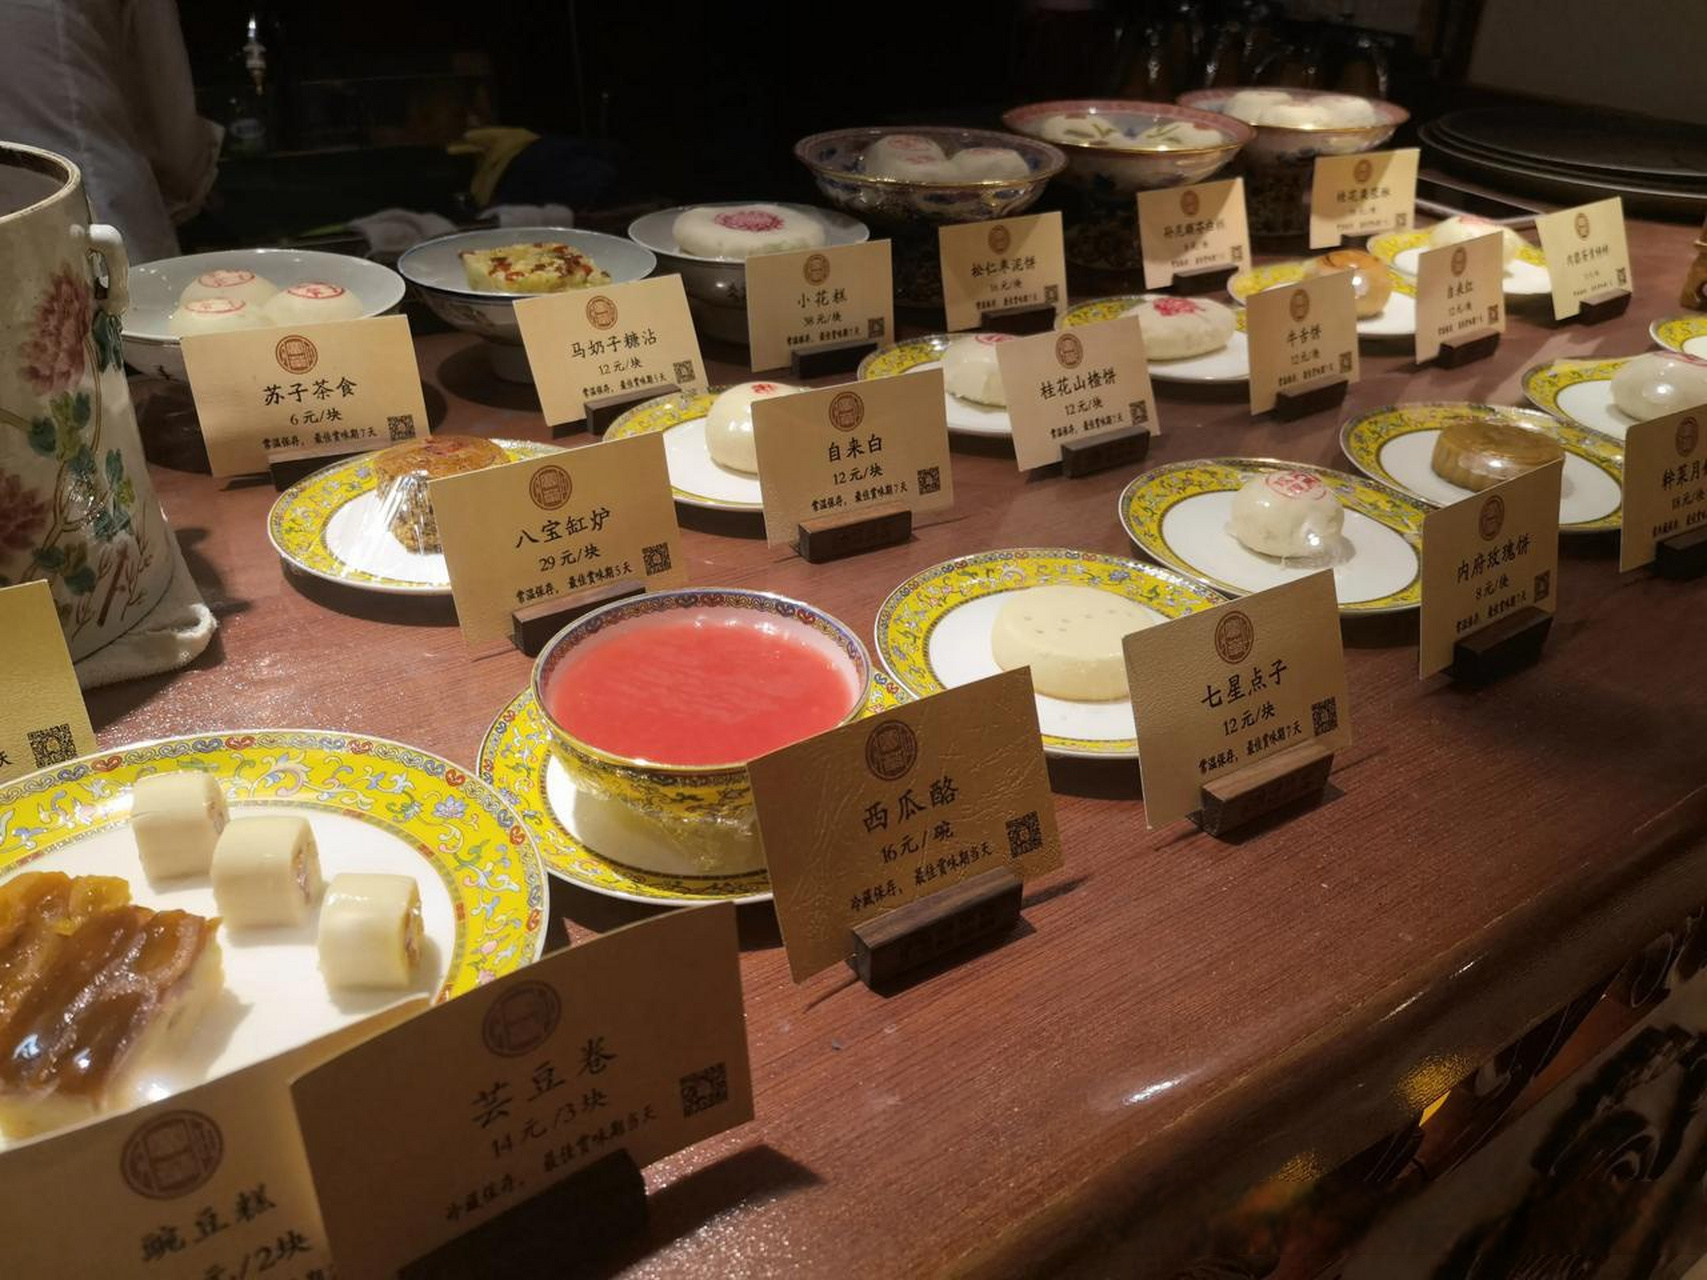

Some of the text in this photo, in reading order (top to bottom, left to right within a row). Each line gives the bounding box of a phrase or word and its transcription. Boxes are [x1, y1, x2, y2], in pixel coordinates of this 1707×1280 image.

[797, 288, 847, 309] 小花糕
[570, 328, 658, 359] 马奶子糖沾
[598, 358, 643, 376] 12元/块
[1040, 366, 1117, 400] 桂花山楂饼
[263, 376, 358, 406] 苏子茶食
[1064, 396, 1104, 416] 12元/块
[290, 408, 343, 426] 6元/块
[828, 433, 882, 462] 自来白
[833, 463, 884, 486] 12元/块
[515, 507, 611, 549] 八宝缸炉
[539, 543, 601, 572] 29元/块
[1456, 532, 1531, 585] 内府玫瑰饼
[1200, 658, 1287, 708] 七星点子
[1223, 701, 1276, 737] 12元/块
[862, 775, 960, 833] 西瓜酪
[882, 820, 954, 864] 16元/碗
[470, 1036, 618, 1129] 芸豆卷
[141, 1182, 277, 1262] 豌豆糕
